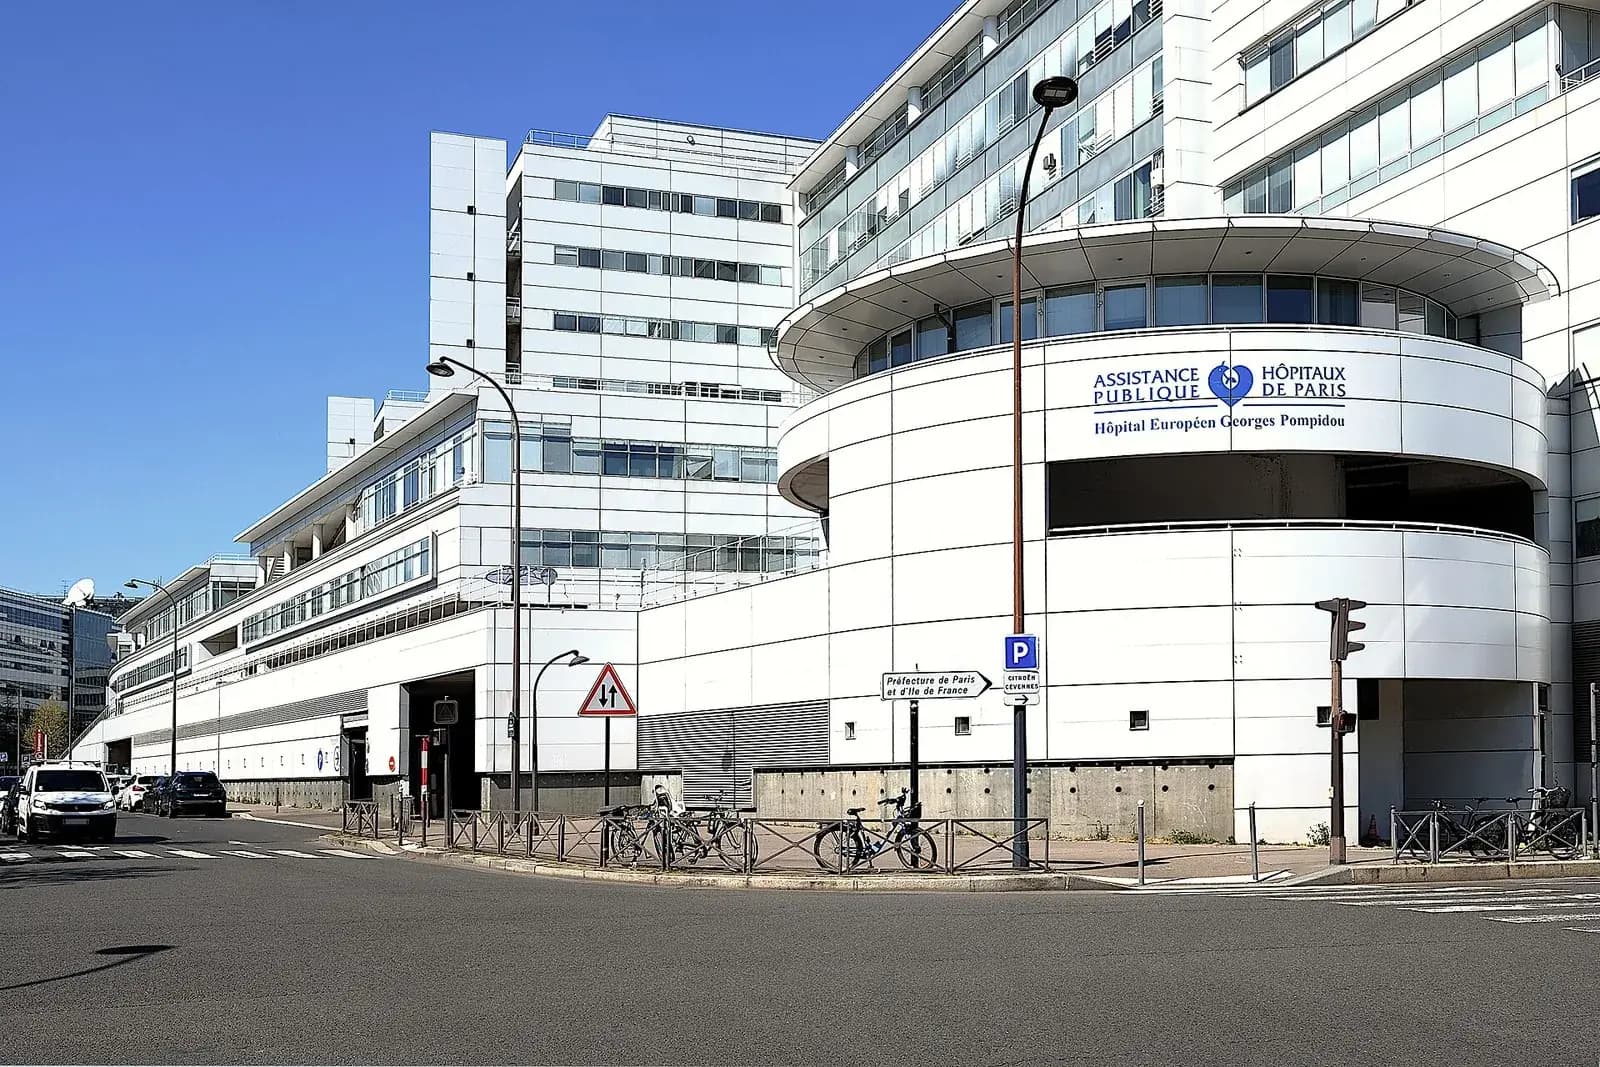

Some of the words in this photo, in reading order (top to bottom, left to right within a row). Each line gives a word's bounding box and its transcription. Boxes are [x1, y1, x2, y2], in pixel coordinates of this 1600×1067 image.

[1093, 368, 1200, 388] ASSISTANCE
[1262, 363, 1346, 380] HÔPITAUX
[1094, 385, 1200, 404] PUBLIQUE
[1262, 383, 1286, 397] DE
[1295, 383, 1346, 397] PARIS
[1095, 420, 1145, 436] Hôpital
[1150, 416, 1216, 432] Européen
[1220, 415, 1275, 430] Georges
[1280, 414, 1345, 429] Pompidou
[1013, 641, 1029, 664] P
[886, 676, 935, 686] Préfecture
[938, 675, 949, 685] de
[952, 674, 975, 684] Paris
[887, 688, 896, 696] et
[923, 686, 934, 695] de
[937, 685, 968, 695] France
